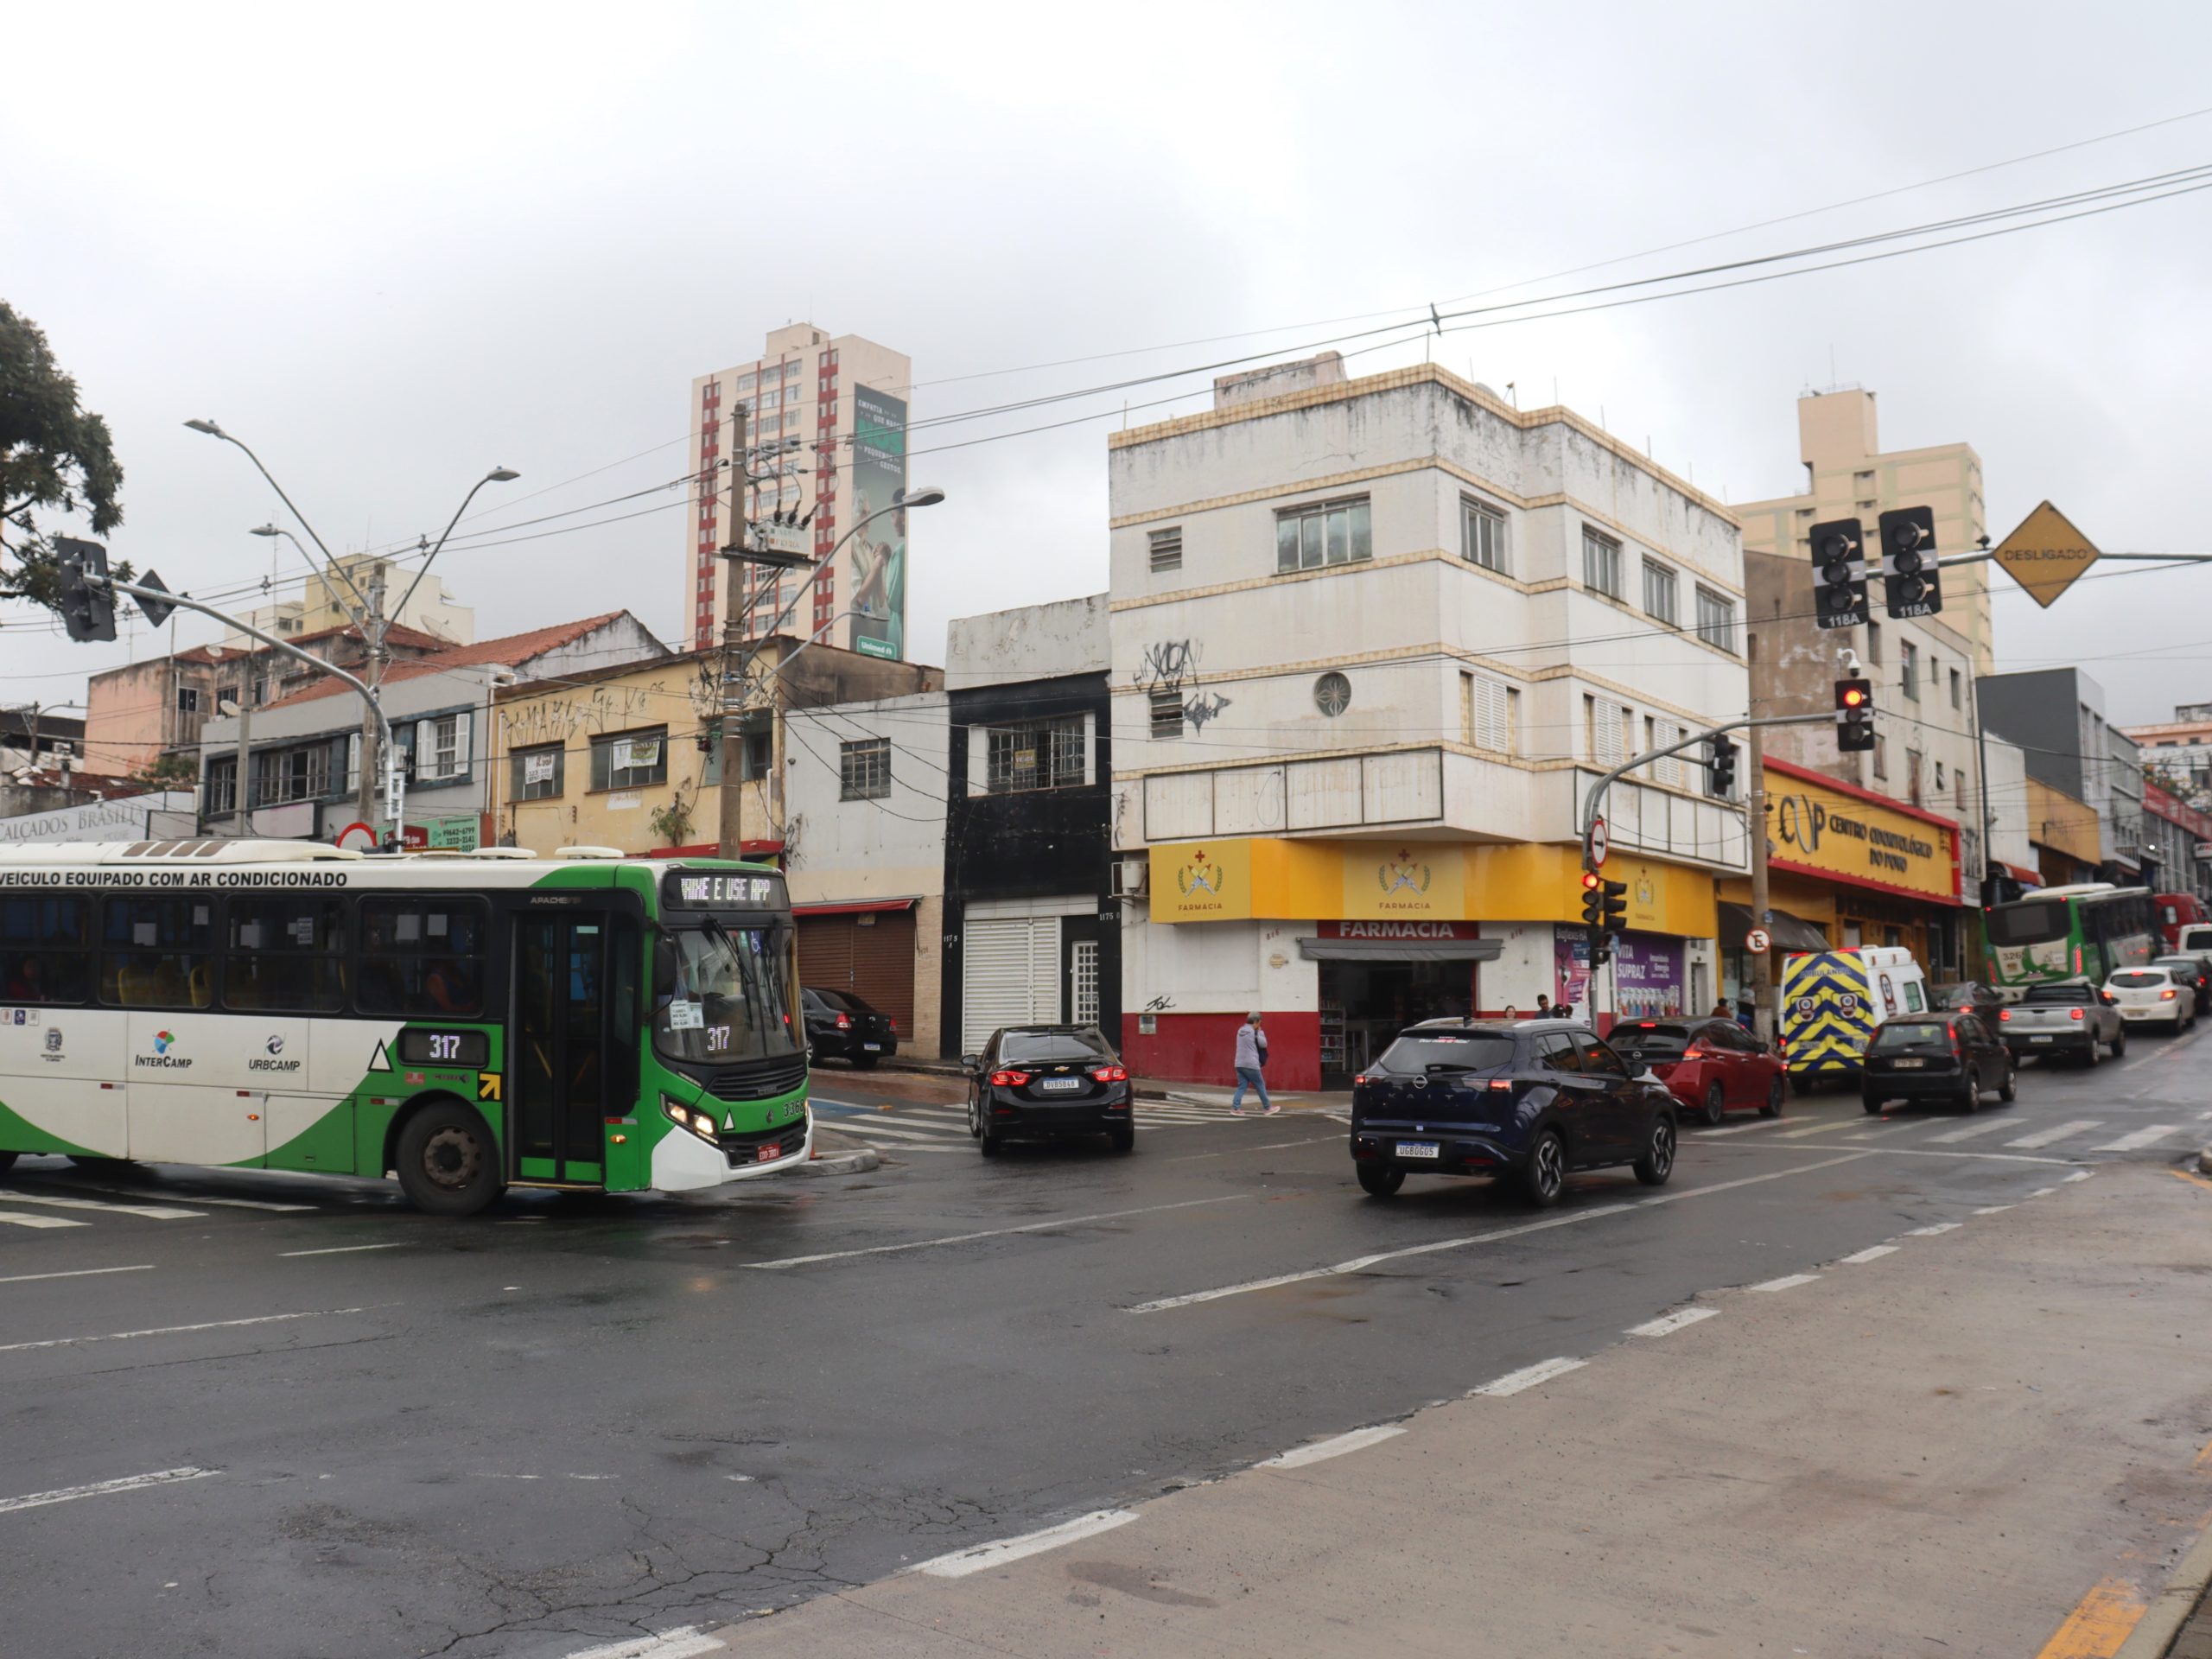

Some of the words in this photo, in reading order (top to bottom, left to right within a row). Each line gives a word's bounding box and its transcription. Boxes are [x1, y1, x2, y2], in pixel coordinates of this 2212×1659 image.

[2005, 549, 2088, 561] DESLIGADO
[1897, 603, 1932, 617] 118A
[1828, 613, 1860, 627] 118A
[861, 640, 887, 653] Unimed
[0, 815, 69, 842] ALÇADOS
[1829, 814, 1867, 840] CENTRO
[66, 872, 143, 886] EQUIPADO
[149, 873, 185, 887] COM
[189, 872, 212, 887] AR
[217, 872, 347, 887] CONDICIONADO
[750, 879, 771, 901] APP
[429, 1035, 460, 1059] 317
[707, 1026, 730, 1051] 317
[248, 1058, 301, 1071] URBCAMP
[783, 1098, 804, 1118] 3368
